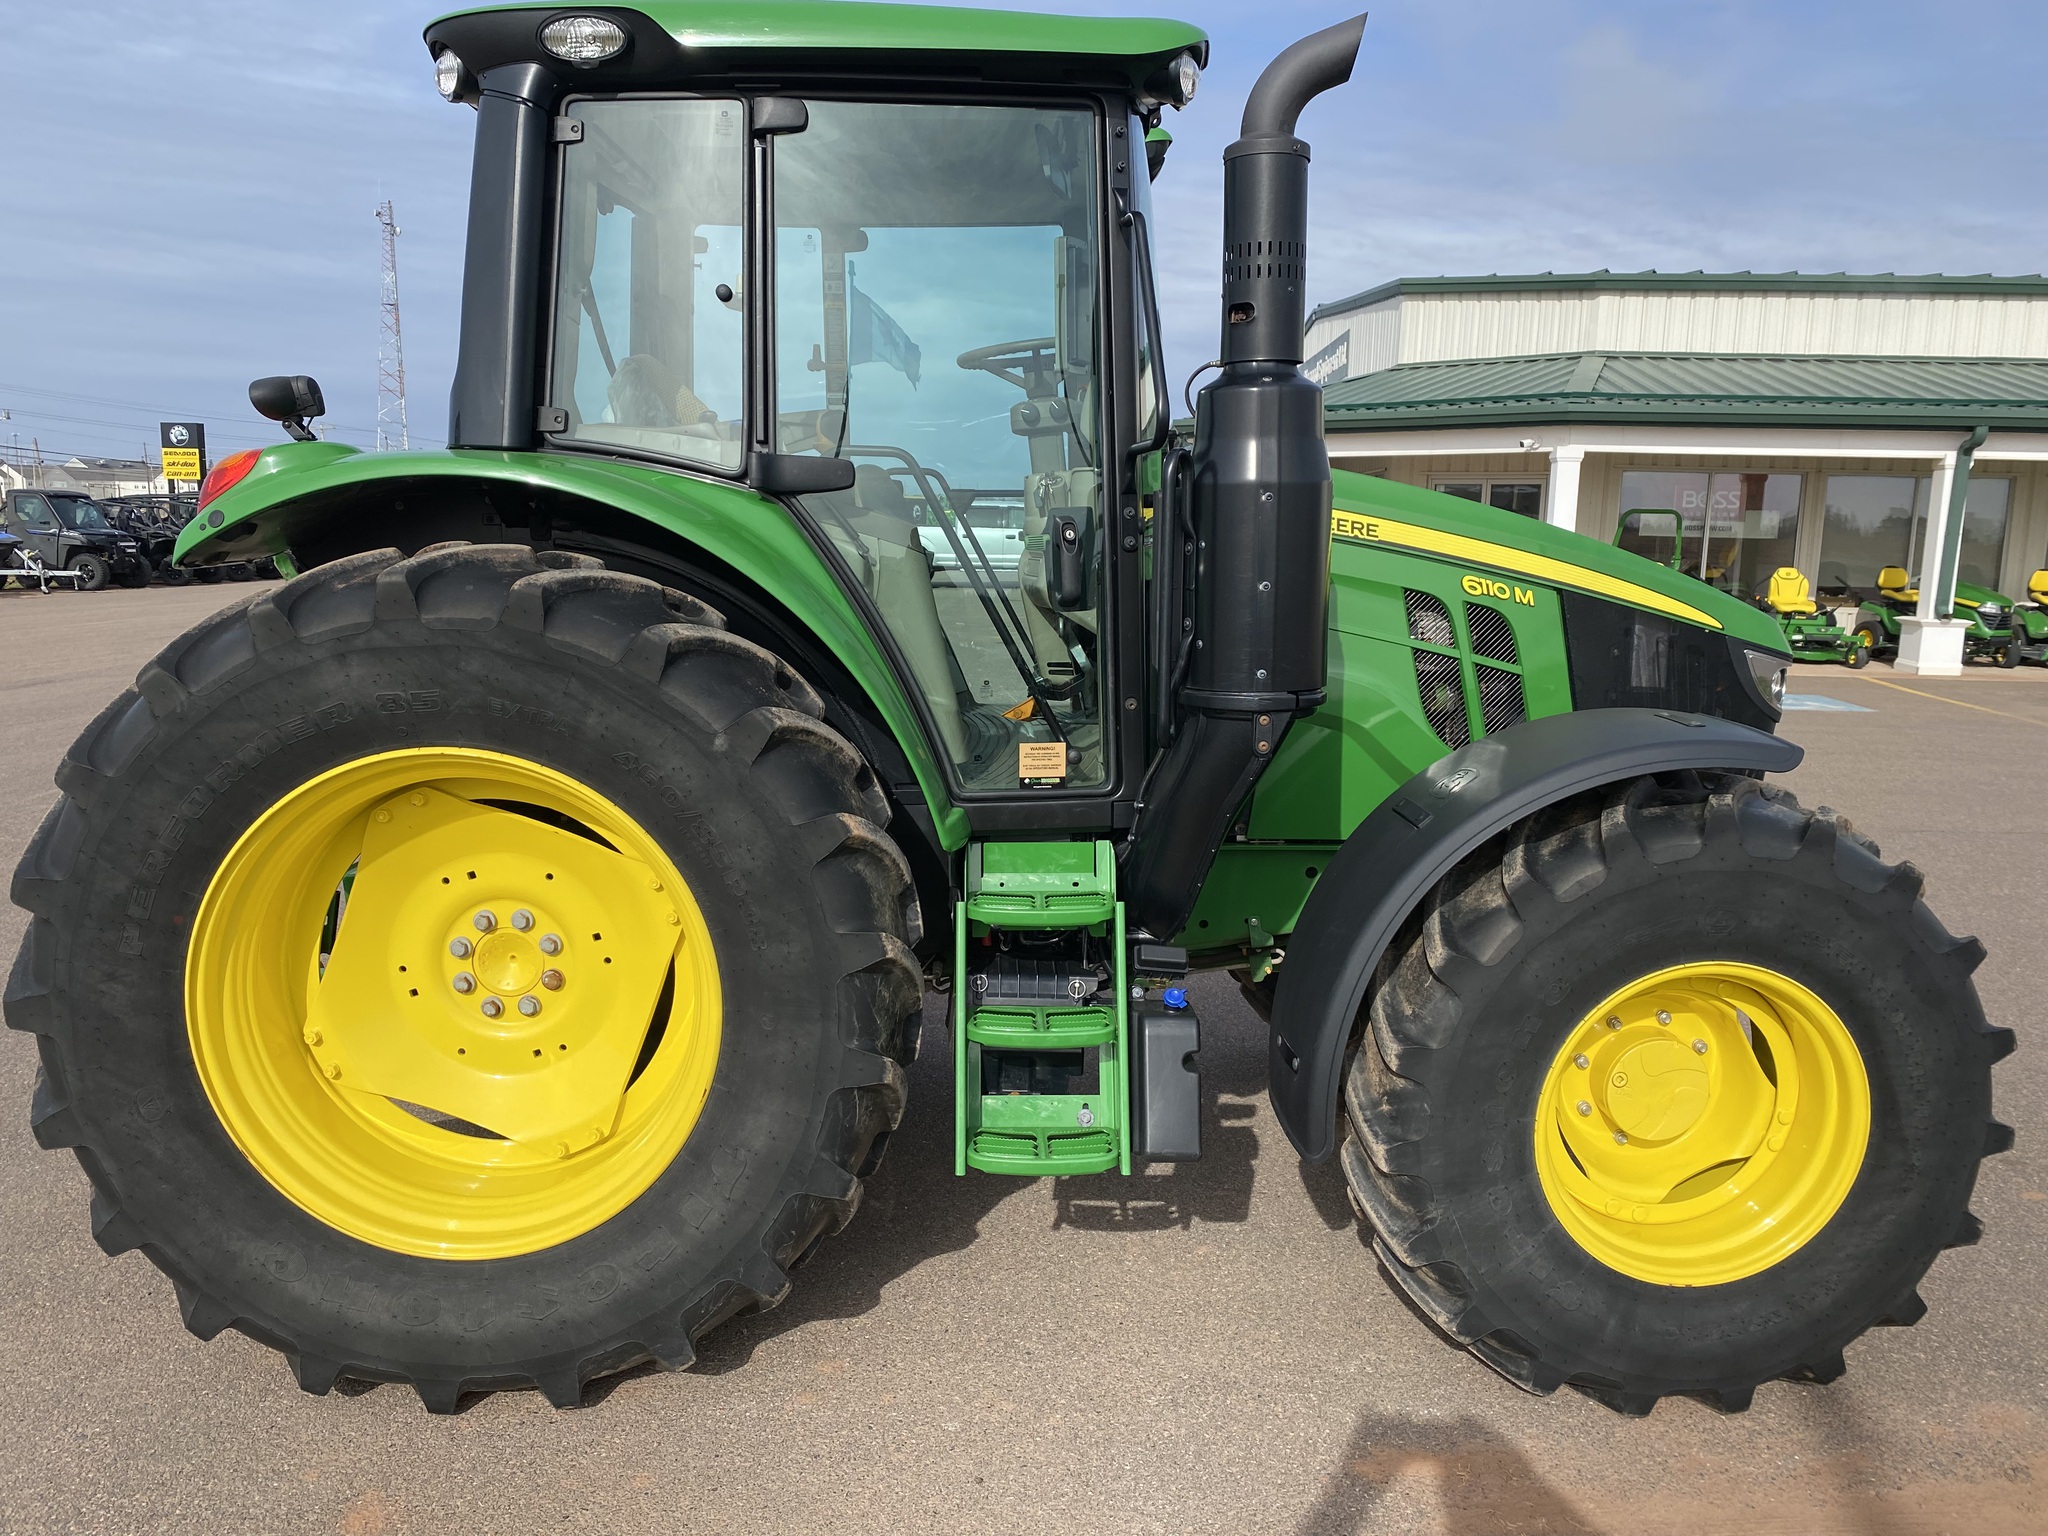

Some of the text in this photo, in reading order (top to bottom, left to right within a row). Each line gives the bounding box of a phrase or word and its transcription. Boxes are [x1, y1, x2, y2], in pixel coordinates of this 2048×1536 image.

[1682, 490, 1741, 508] BOSS
[1331, 516, 1380, 539] ERE
[1460, 574, 1536, 607] 6110 M
[487, 695, 571, 738] EXTRA
[118, 688, 443, 956] PERFORMER 85
